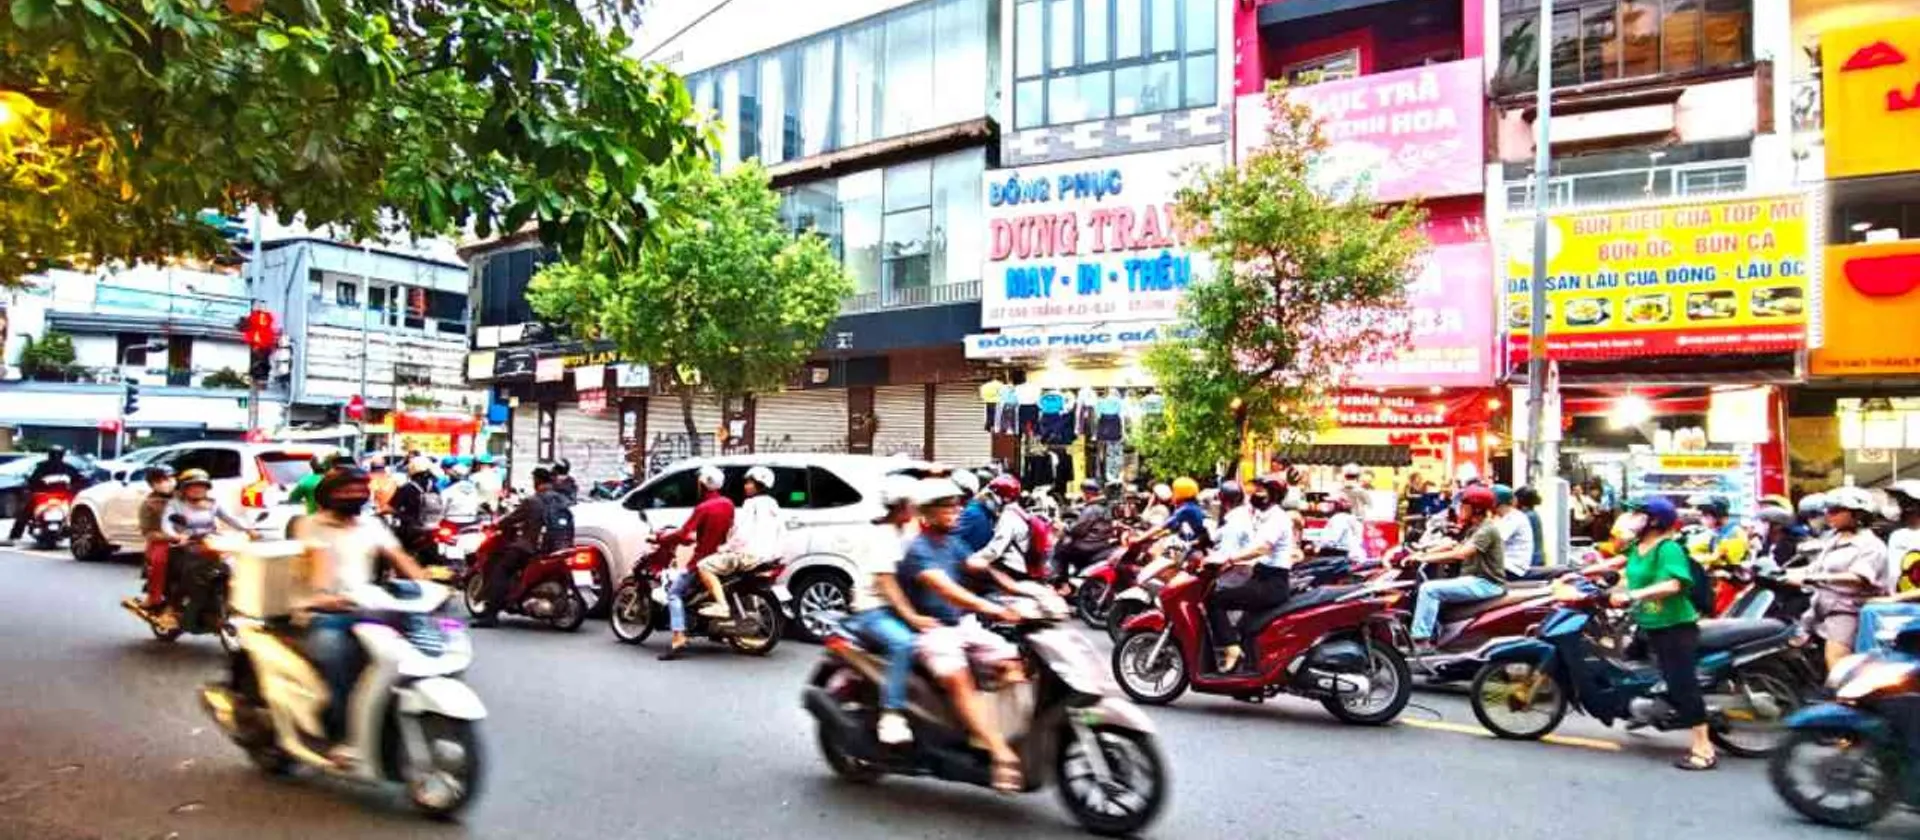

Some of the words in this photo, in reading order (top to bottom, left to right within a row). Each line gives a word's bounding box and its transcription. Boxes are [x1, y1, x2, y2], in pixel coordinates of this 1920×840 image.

[1391, 107, 1457, 134] HOA
[1058, 169, 1123, 203] PHỤC
[1088, 203, 1202, 254] TRAN
[1005, 266, 1056, 299] MAY
[1077, 264, 1102, 295] IN
[1124, 250, 1192, 291] THÊU
[1047, 331, 1112, 349] PHỤC
